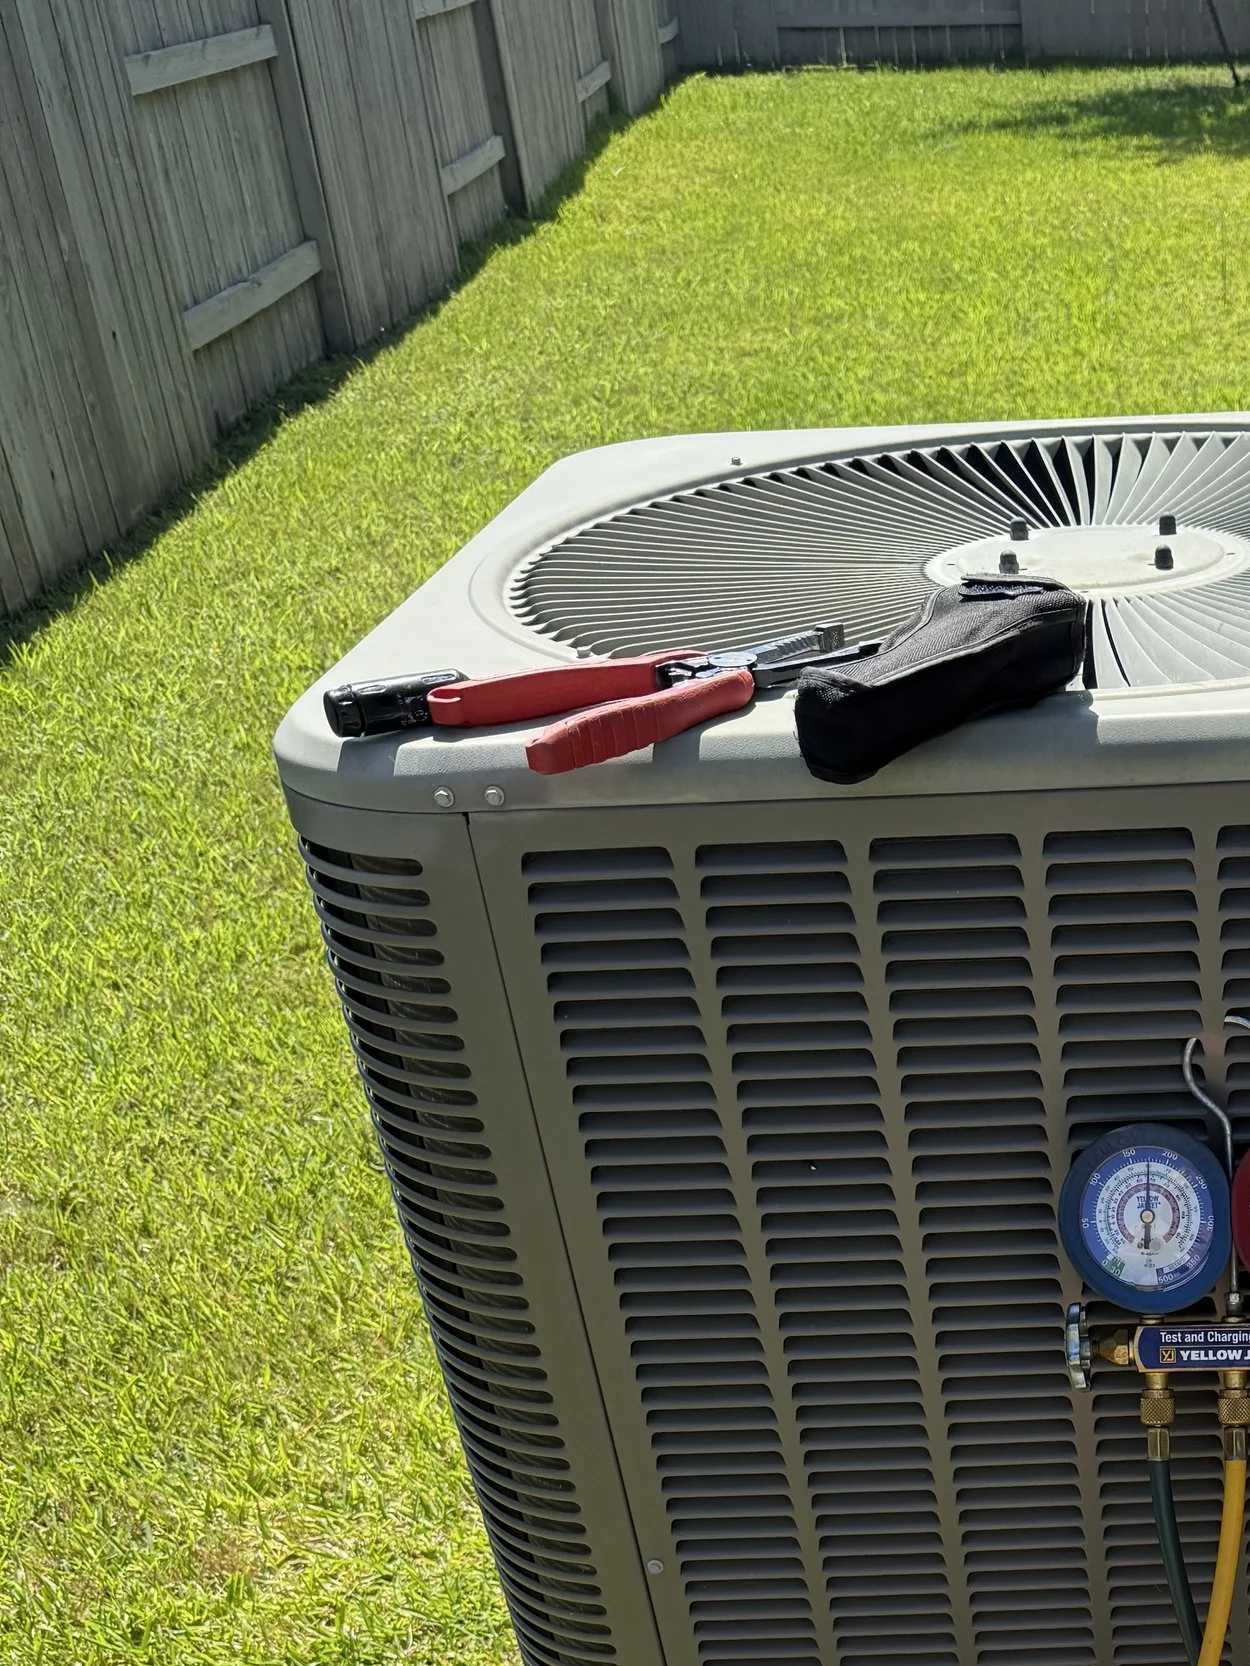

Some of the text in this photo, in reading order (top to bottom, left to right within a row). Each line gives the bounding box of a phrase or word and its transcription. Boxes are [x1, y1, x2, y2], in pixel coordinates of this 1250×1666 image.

[1122, 1148, 1136, 1158] 150
[1162, 1150, 1178, 1160] 200
[1090, 1172, 1101, 1186] 100
[1195, 1175, 1208, 1190] 250
[1081, 1218, 1089, 1229] 50
[1186, 1254, 1201, 1269] 350
[1111, 1266, 1120, 1276] 30
[1158, 1273, 1174, 1284] 500
[1160, 1331, 1182, 1343] Test
[1184, 1331, 1204, 1342] and
[1180, 1349, 1242, 1361] YELLOW
